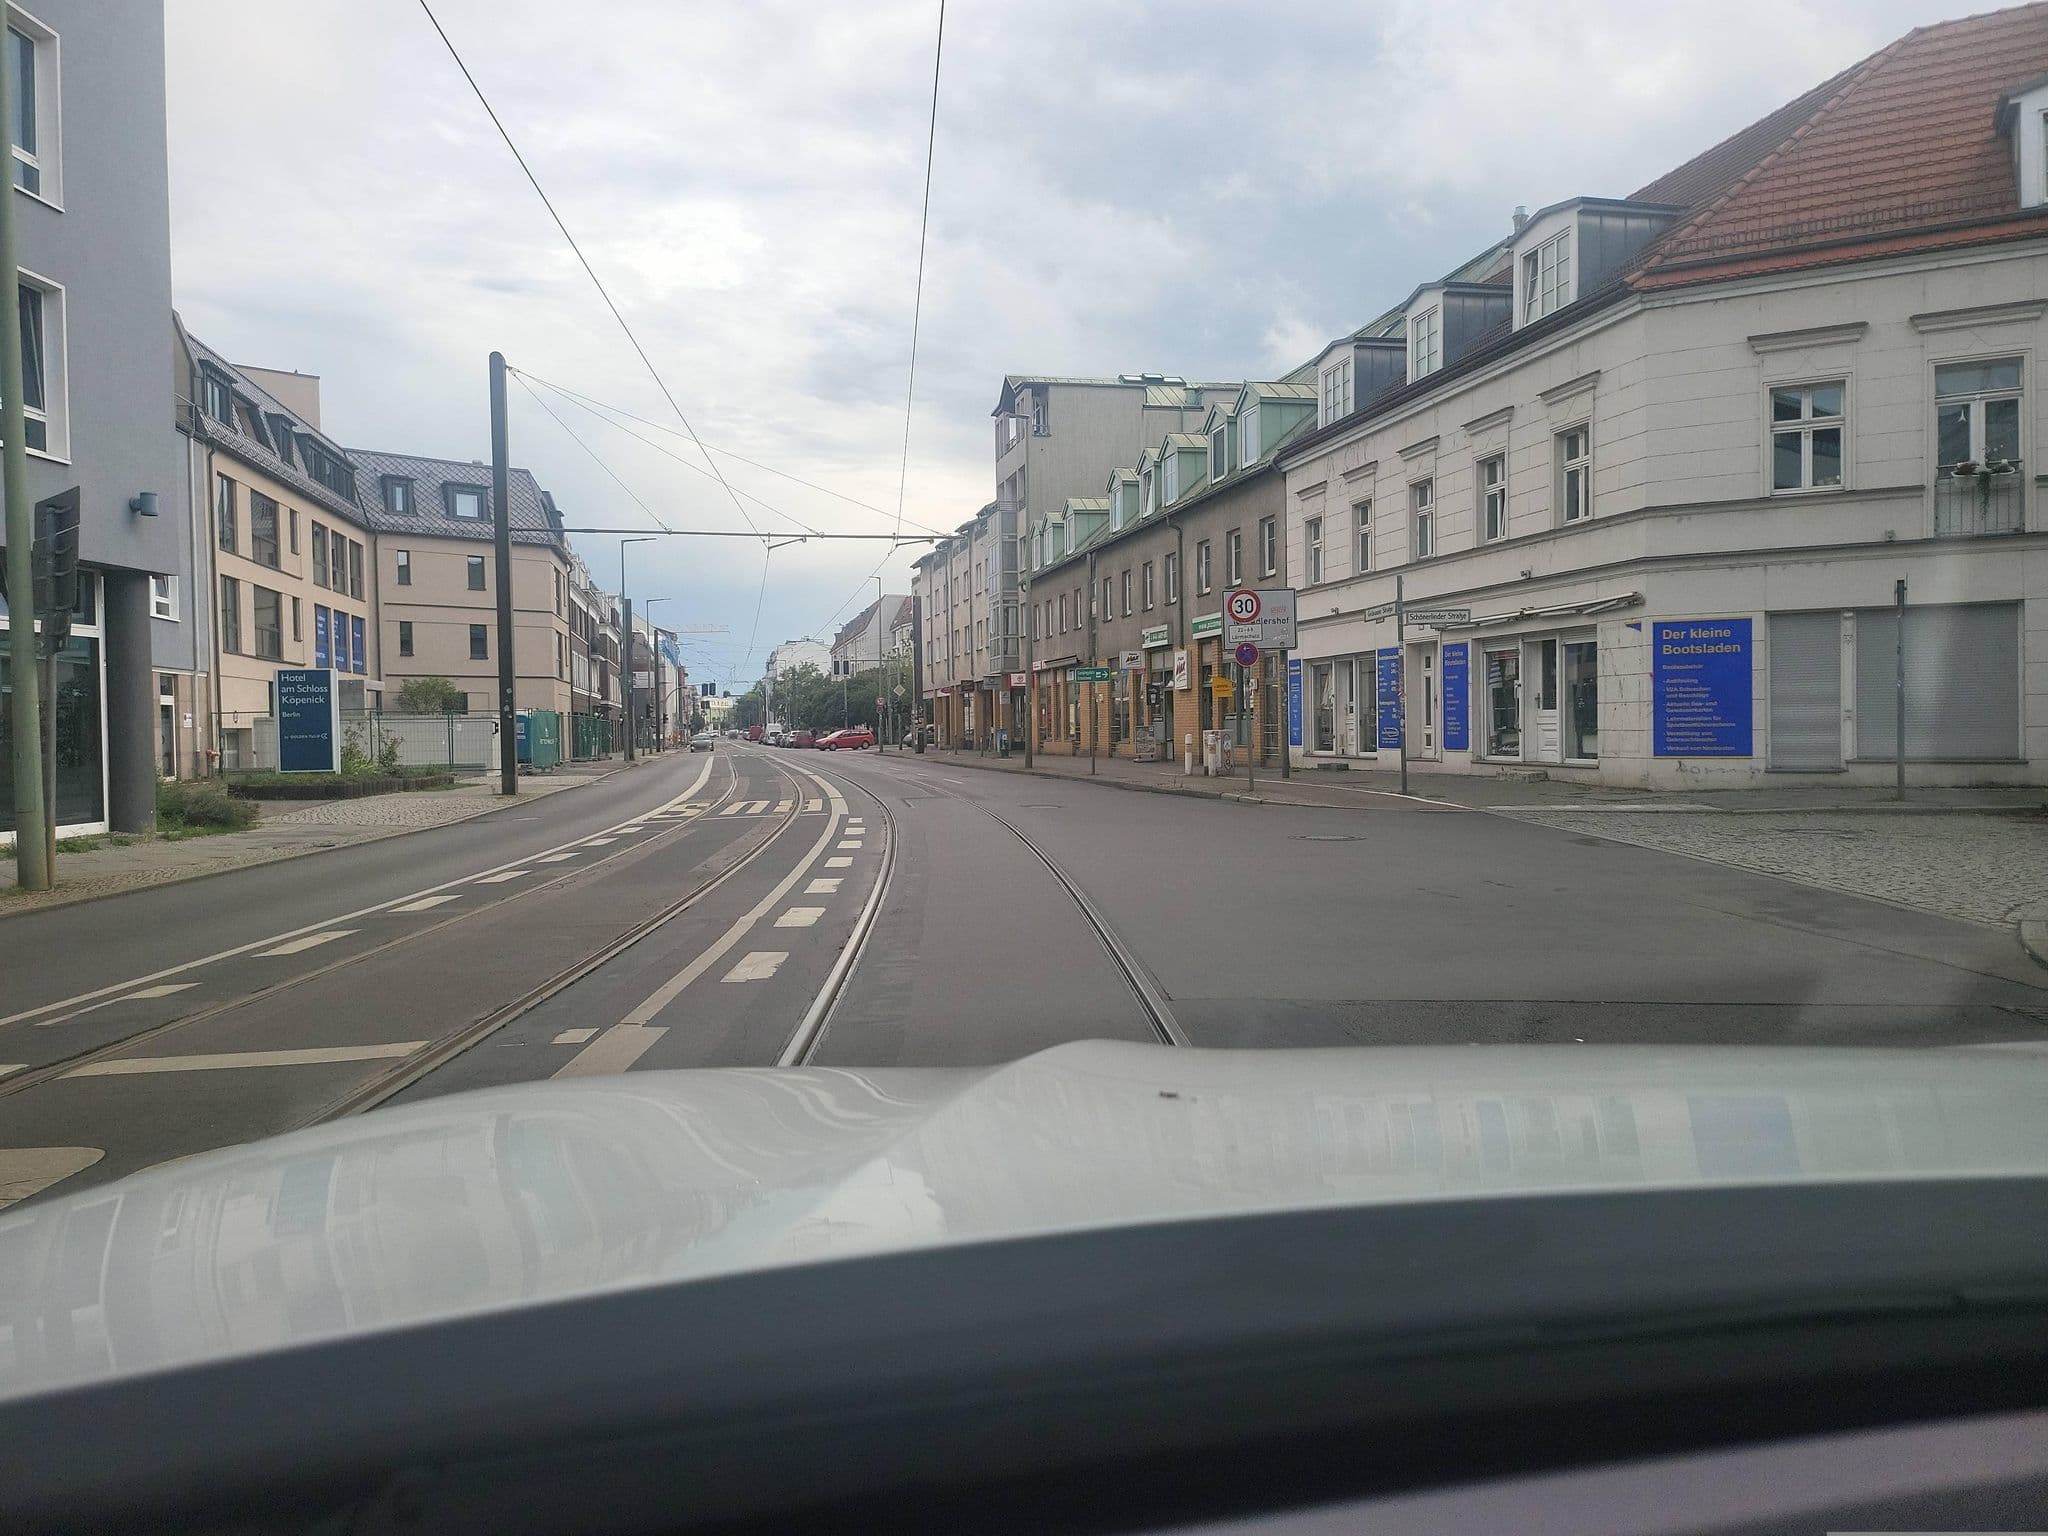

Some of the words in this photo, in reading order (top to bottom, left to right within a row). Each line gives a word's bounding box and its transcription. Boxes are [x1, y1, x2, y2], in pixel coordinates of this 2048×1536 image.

[1234, 598, 1254, 614] 30
[1409, 612, 1446, 621] Schönerlinder
[1447, 611, 1467, 620] Straße
[1662, 629, 1687, 640] Der
[1690, 627, 1732, 639] kleine
[1662, 642, 1741, 655] Bootsladen
[281, 673, 306, 682] Hotel
[297, 684, 328, 693] Schloss
[281, 695, 325, 706] Köpenick
